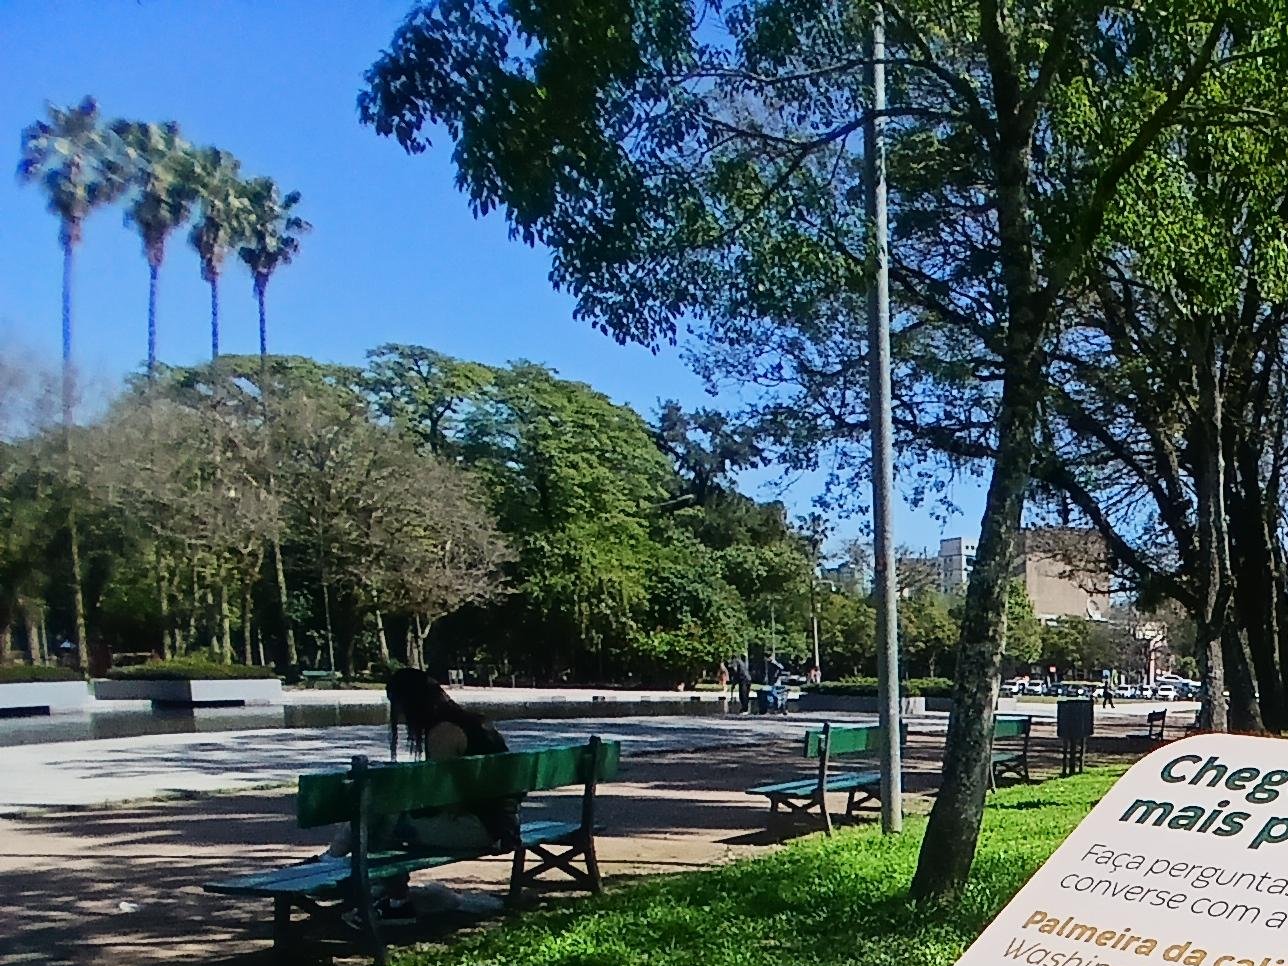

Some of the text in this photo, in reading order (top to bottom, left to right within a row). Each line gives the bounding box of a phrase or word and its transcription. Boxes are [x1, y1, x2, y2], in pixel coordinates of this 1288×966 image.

[1118, 796, 1251, 838] mais
[1081, 843, 1145, 874] Faça
[1060, 873, 1288, 929] converse com a
[1021, 910, 1158, 957] Palmeira
